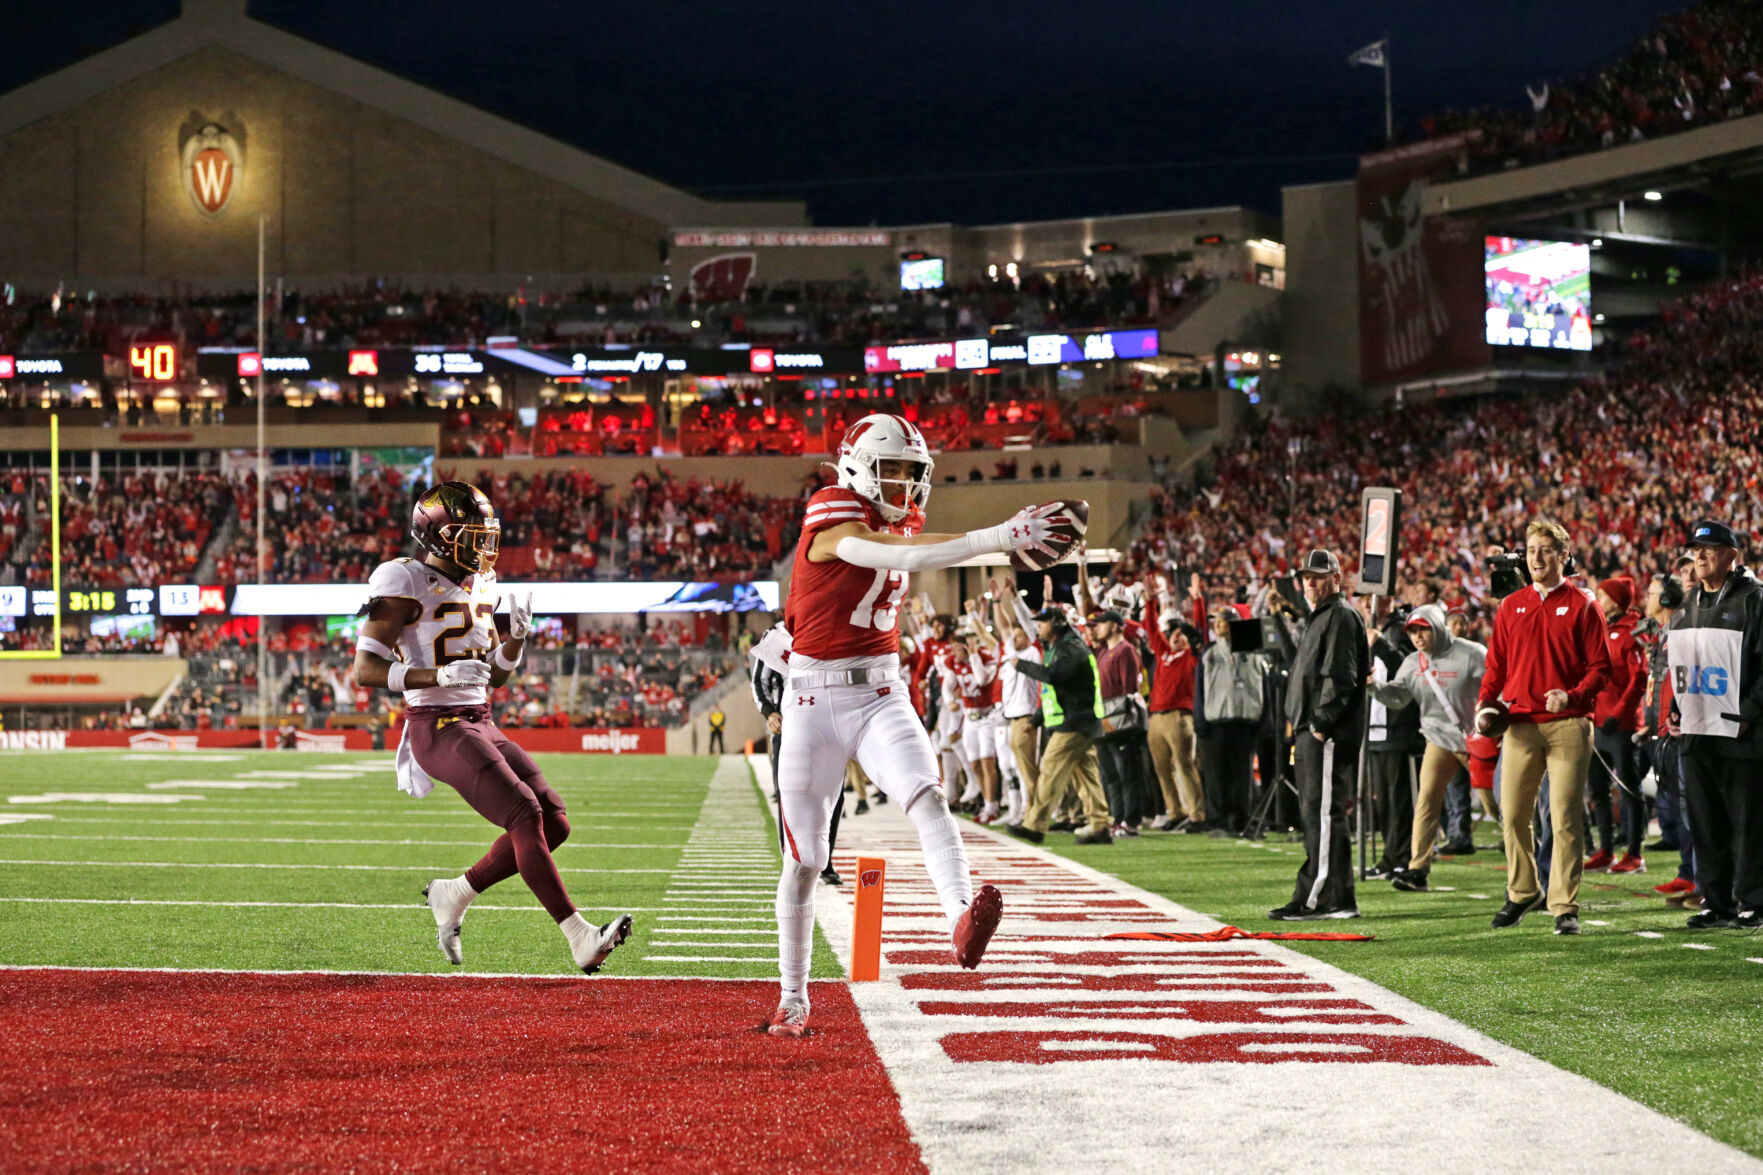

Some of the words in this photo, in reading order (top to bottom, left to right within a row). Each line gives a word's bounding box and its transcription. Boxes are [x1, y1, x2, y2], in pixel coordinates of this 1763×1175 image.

[195, 157, 228, 204] W
[16, 360, 63, 373] TOYOTA
[131, 345, 174, 380] 40
[774, 354, 823, 367] TOYOTA
[1365, 499, 1388, 552] 2
[69, 591, 115, 611] 3:15
[581, 729, 640, 754] meijer
